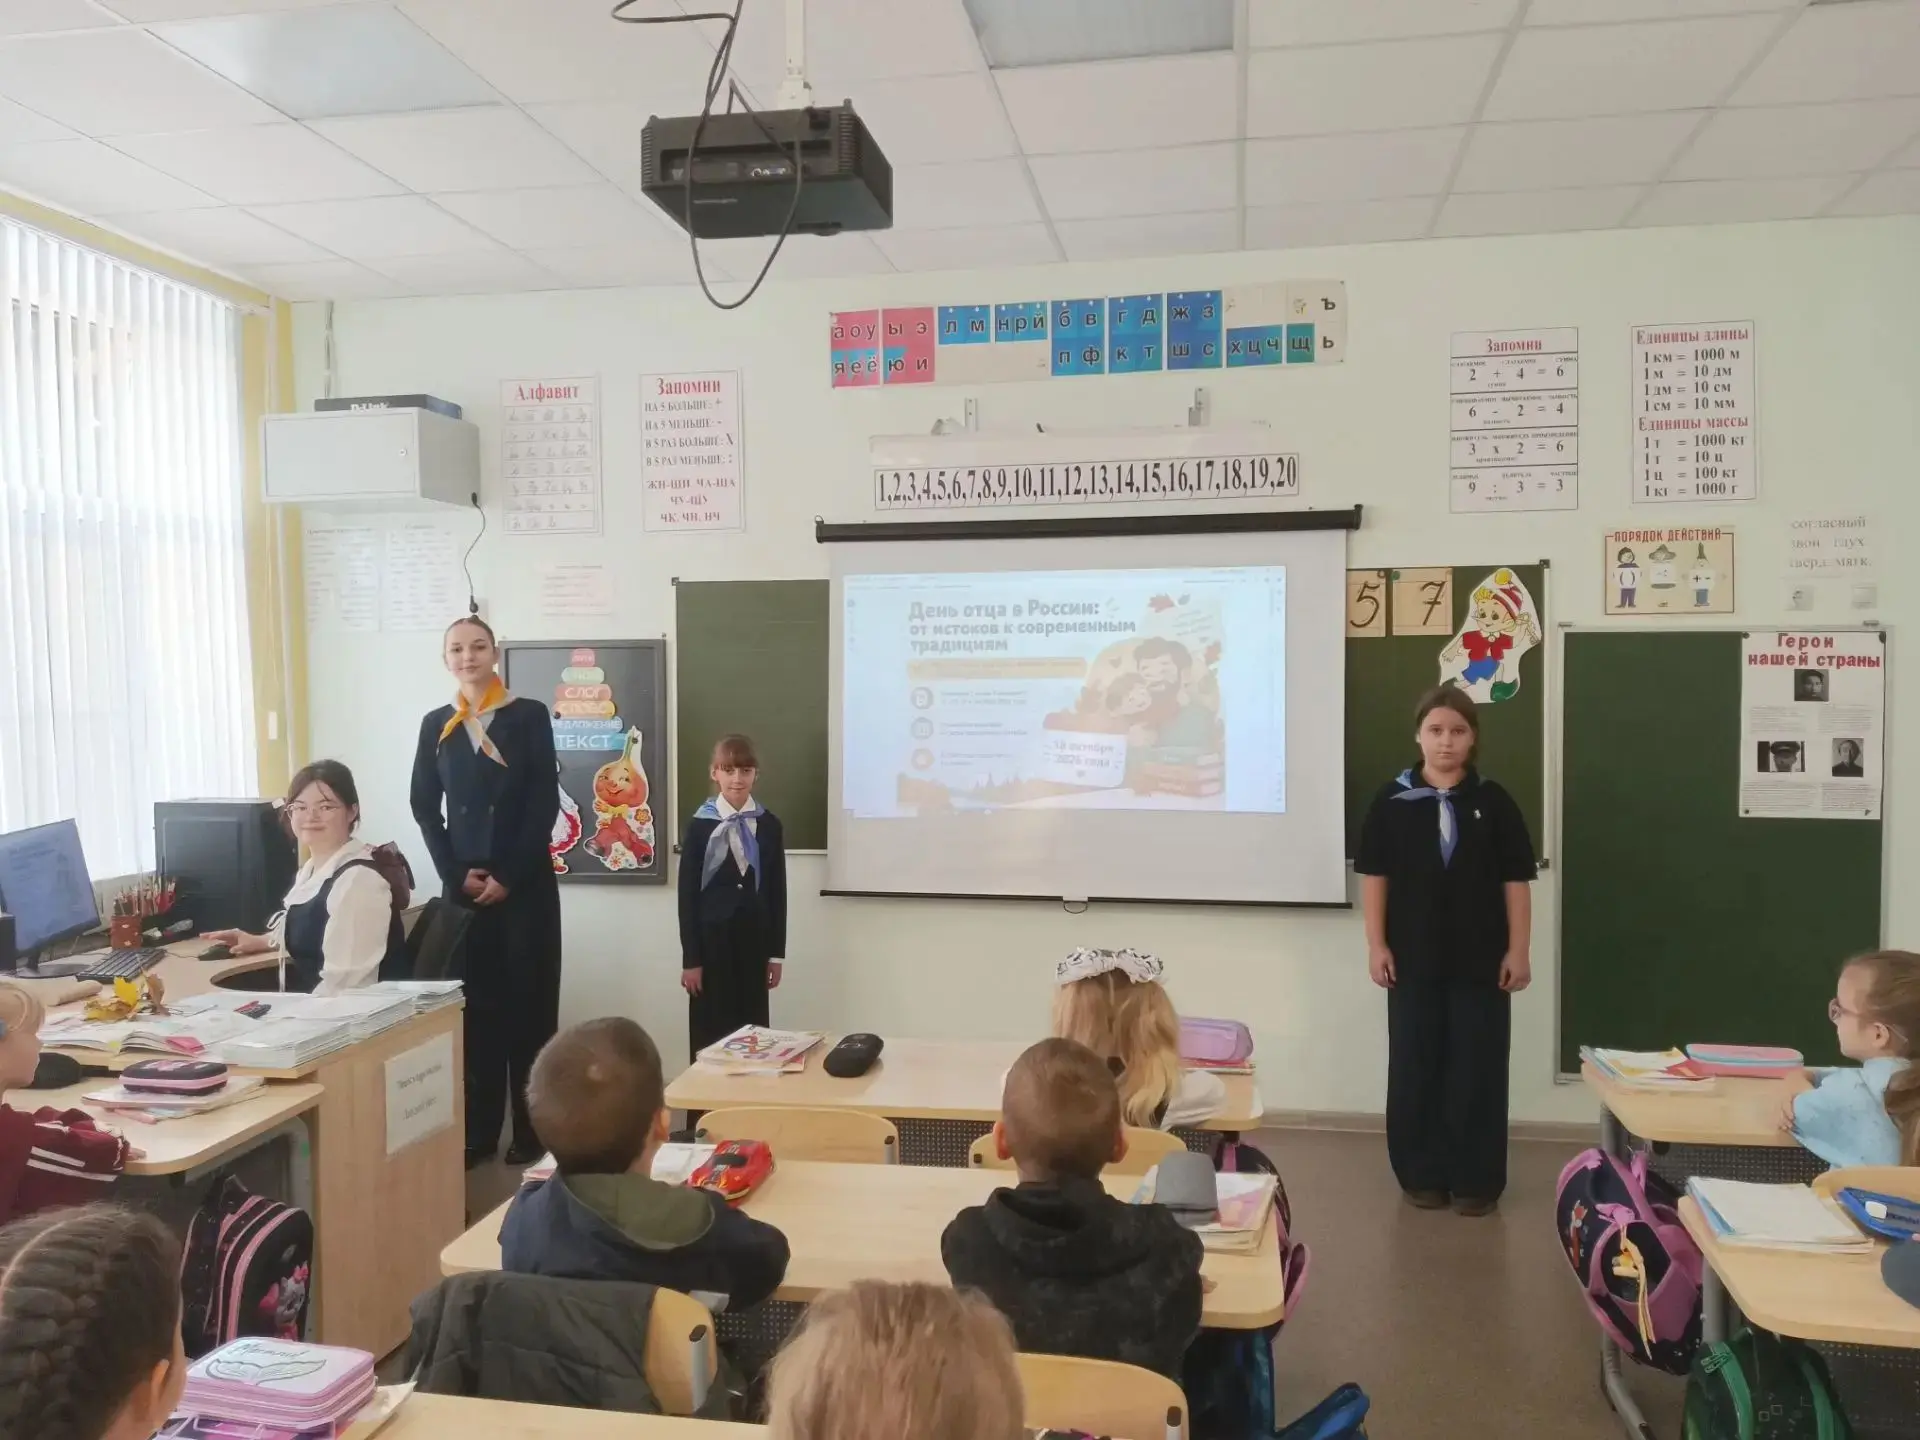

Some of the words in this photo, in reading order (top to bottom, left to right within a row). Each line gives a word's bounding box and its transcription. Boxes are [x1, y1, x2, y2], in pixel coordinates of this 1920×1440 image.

[1637, 329, 1699, 345] Единицы
[1704, 327, 1749, 342] длины
[1487, 338, 1542, 353] Запомни
[1644, 351, 1650, 364] 1
[1653, 353, 1673, 363] км
[1694, 347, 1726, 361] 1000
[1730, 350, 1740, 360] м
[1469, 368, 1477, 382] 2
[1517, 367, 1524, 380] 4
[1556, 366, 1564, 378] 6
[1644, 367, 1650, 380] 1
[1653, 370, 1664, 380] м
[1694, 364, 1709, 378] 10
[1713, 367, 1732, 377] дм
[515, 382, 580, 403] Алфавит
[657, 377, 721, 396] Запомни
[1644, 383, 1650, 396] 1
[1653, 385, 1672, 396] дм
[1694, 381, 1709, 394] 10
[1714, 383, 1731, 393] см
[1469, 406, 1477, 418] 6
[1517, 404, 1524, 417] 2
[1556, 402, 1564, 415] 4
[1644, 400, 1650, 412] 1
[1653, 402, 1671, 412] см
[1694, 397, 1709, 410] 10
[1714, 399, 1735, 409] мм
[1639, 416, 1701, 432] Единицы
[1707, 415, 1749, 429] массы
[1468, 442, 1476, 456] 3
[1517, 442, 1524, 455] 2
[1556, 440, 1564, 452] 6
[1644, 436, 1650, 449] 1
[1694, 434, 1726, 447] 1000
[1731, 436, 1746, 446] кг
[1644, 452, 1650, 465] 1
[1694, 450, 1710, 463] 10
[1644, 468, 1650, 481] 1
[1694, 466, 1718, 479] 100
[1722, 469, 1738, 479] кг
[1469, 481, 1477, 494] 9
[1517, 481, 1524, 494] 3
[1556, 478, 1564, 492] 3
[1644, 485, 1650, 497] 1
[1654, 487, 1669, 497] кг
[1694, 482, 1726, 496] 1000
[1614, 530, 1663, 543] ПОРЯДОК
[909, 602, 958, 622] День
[964, 603, 1007, 620] отца
[1012, 603, 1023, 617] в
[1028, 599, 1100, 617] России:
[1349, 580, 1381, 628] 5
[1420, 580, 1447, 626] 7
[910, 623, 928, 635] от
[933, 623, 999, 636] истоков
[1005, 621, 1014, 634] к
[1017, 620, 1136, 638] современным
[910, 639, 1008, 656] традициям
[1778, 633, 1835, 652] Герои
[1748, 651, 1809, 667] нашей
[1816, 654, 1881, 670] страны
[565, 687, 602, 699] СЛОГ
[556, 734, 612, 749] ТЕКСТ
